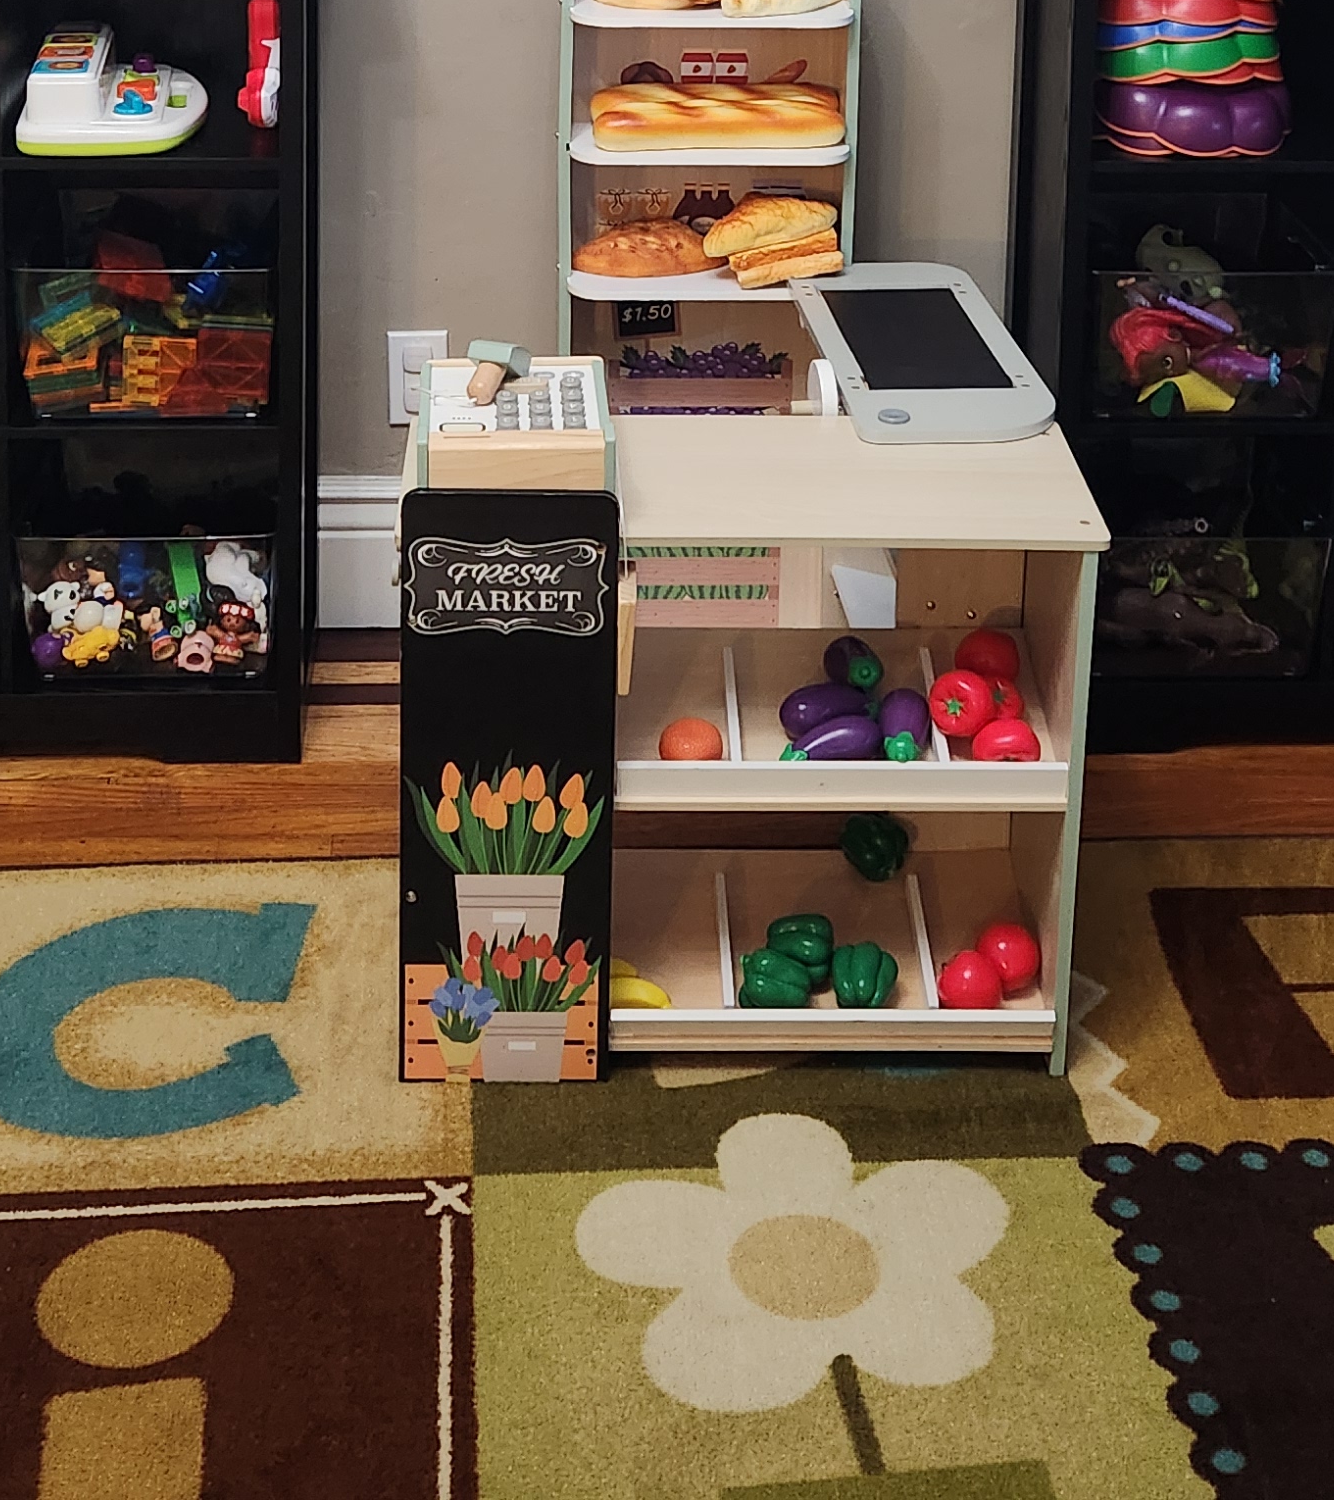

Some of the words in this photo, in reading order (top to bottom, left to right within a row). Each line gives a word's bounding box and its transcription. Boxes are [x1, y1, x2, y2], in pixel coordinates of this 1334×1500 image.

[621, 303, 673, 324] $1.50
[446, 562, 566, 587] FRESH
[434, 589, 583, 612] MARKET
